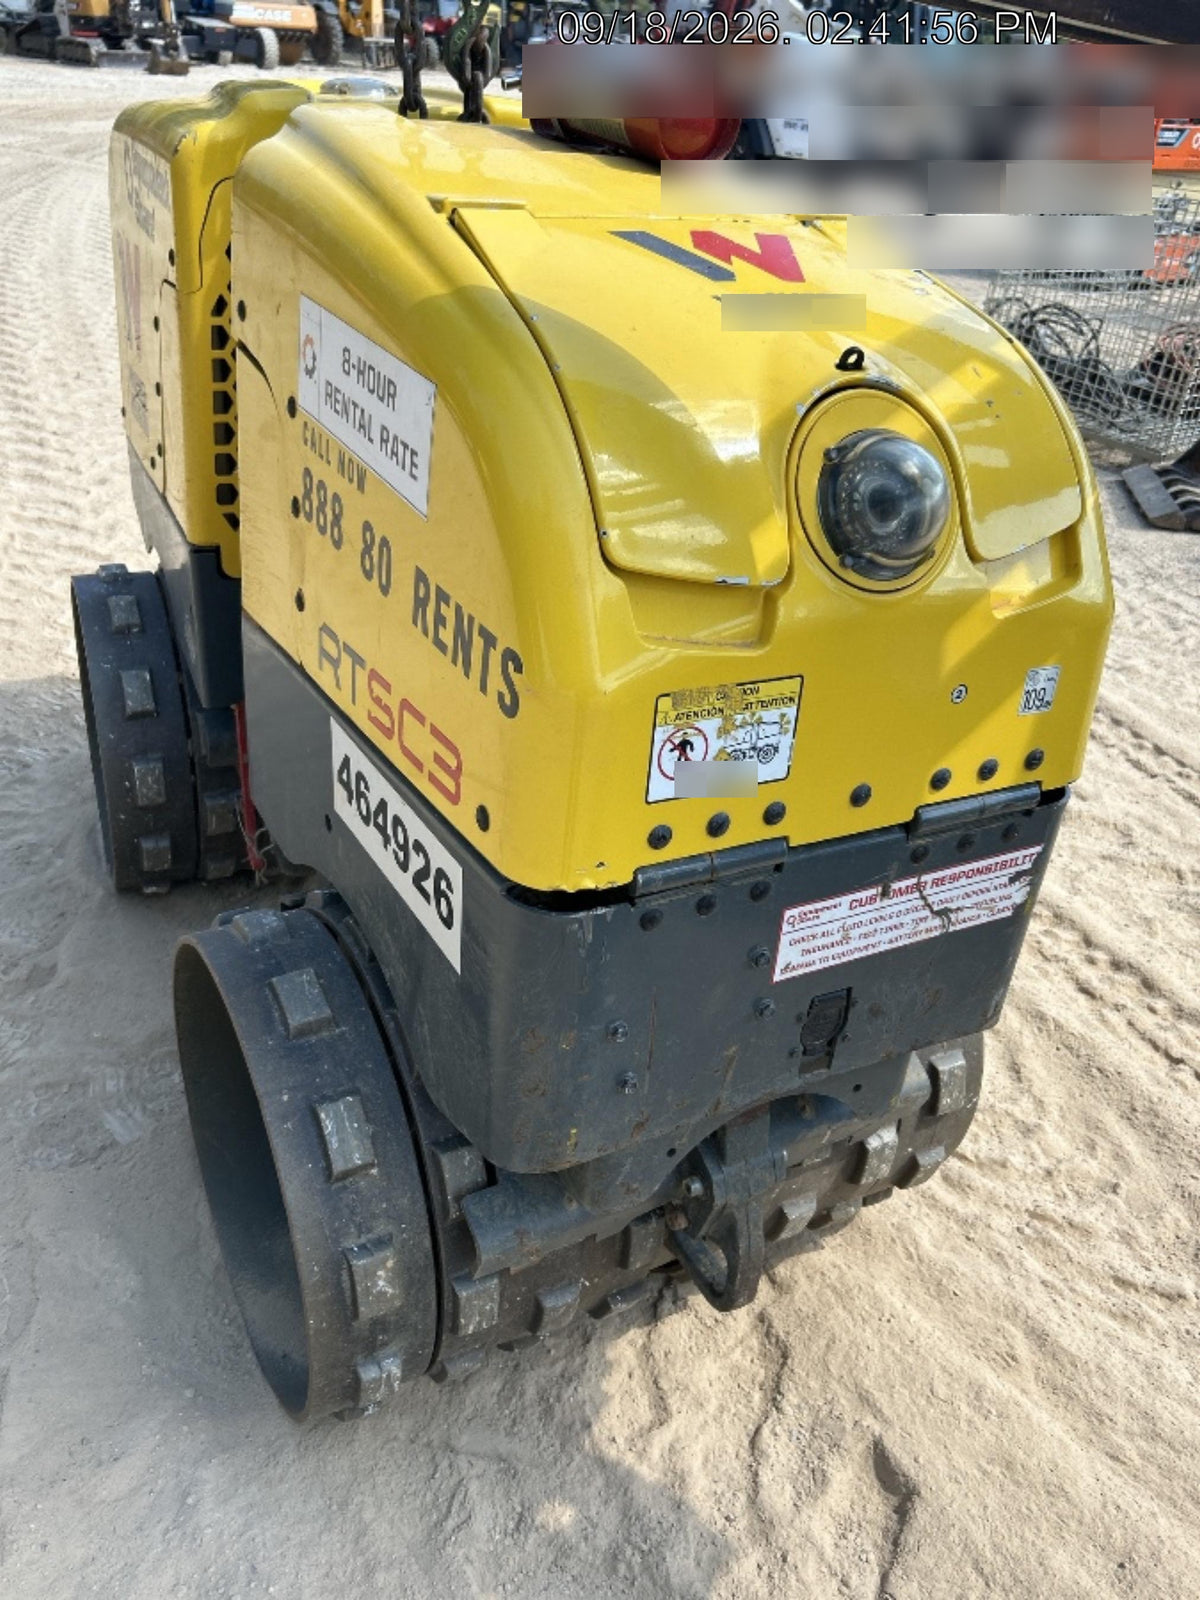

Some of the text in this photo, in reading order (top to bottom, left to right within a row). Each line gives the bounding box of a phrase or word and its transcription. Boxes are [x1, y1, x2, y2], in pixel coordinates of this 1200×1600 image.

[341, 345, 398, 413] 8-HOUR
[302, 420, 368, 495] CALL NOW
[324, 379, 419, 481] RENTAL RATE
[301, 466, 524, 719] 888 80 RENTS
[336, 753, 455, 931] 464926
[930, 852, 1037, 889] RESPONSIBILIT
